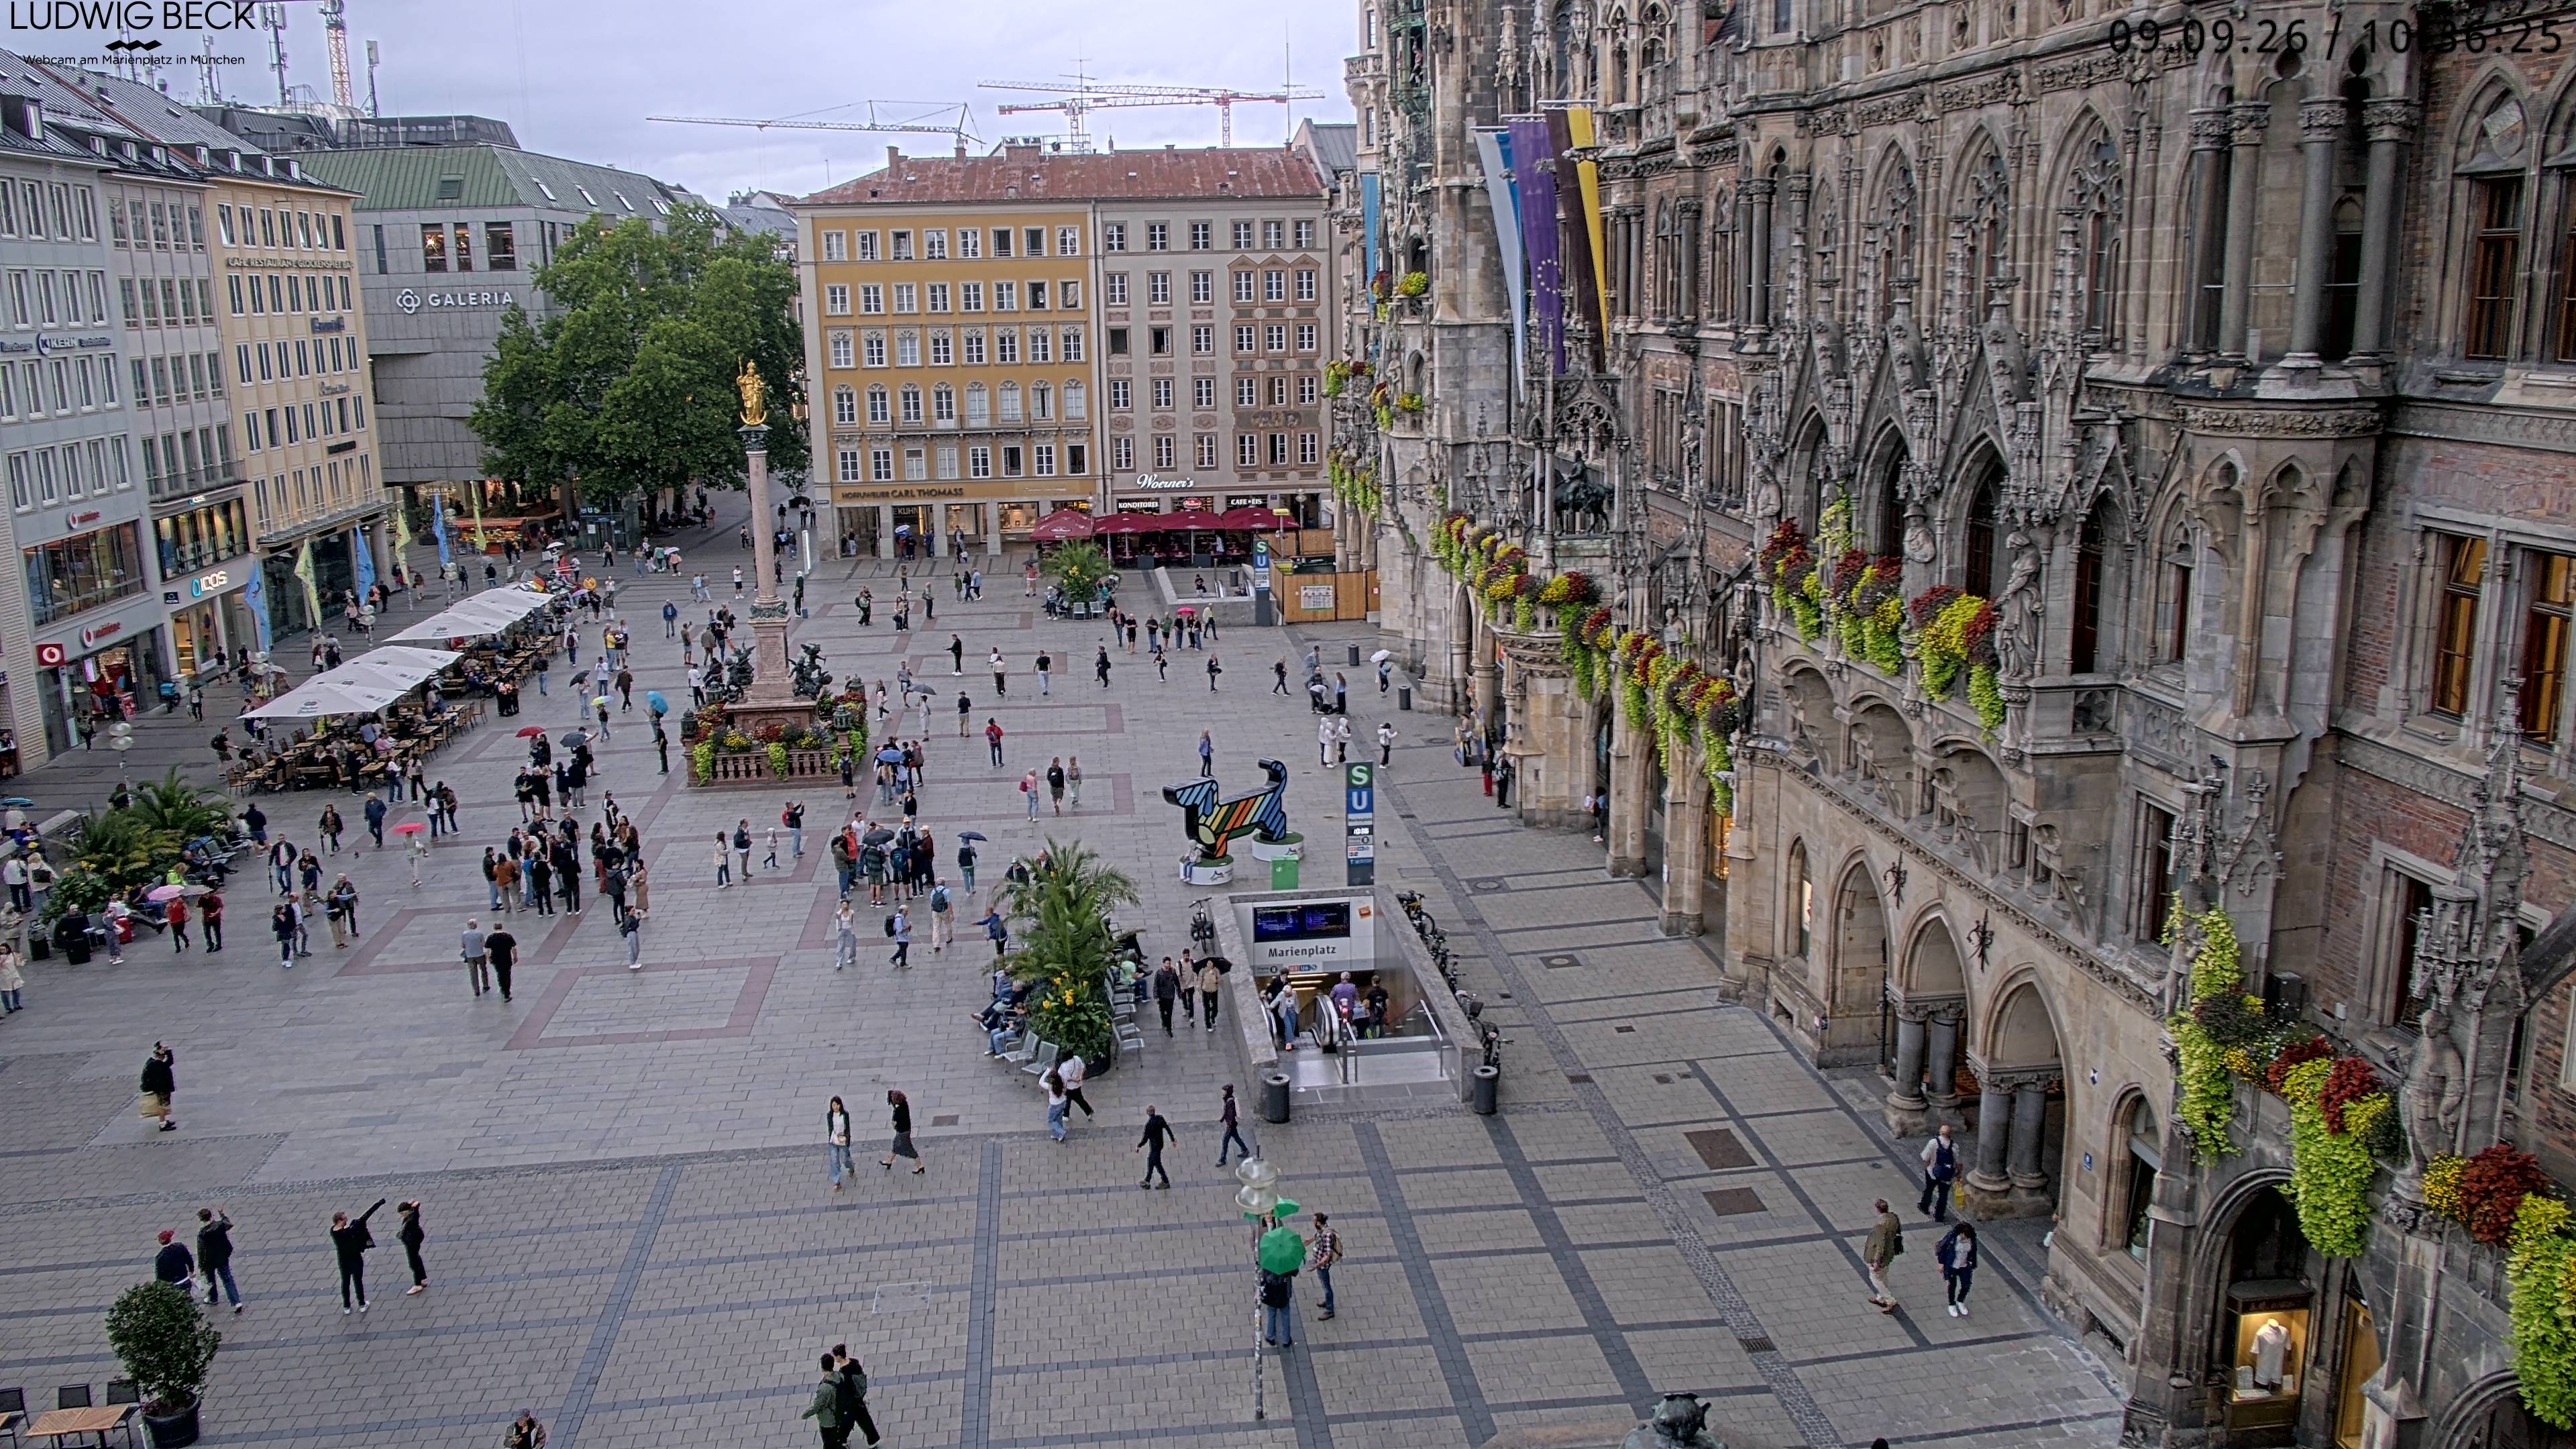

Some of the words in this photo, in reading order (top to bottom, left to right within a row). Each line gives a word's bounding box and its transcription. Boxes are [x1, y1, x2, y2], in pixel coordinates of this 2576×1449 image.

[428, 291, 513, 307] GALERIA
[50, 337, 76, 349] KERN
[1136, 474, 1194, 489] Woerner's
[891, 489, 915, 498] CARL
[916, 488, 964, 498] THOMASS
[1256, 541, 1267, 553] S
[1256, 555, 1267, 567] U
[201, 570, 228, 592] IQOS
[1351, 765, 1369, 786] S
[1352, 791, 1368, 810] U
[1268, 945, 1337, 958] Marienplatz
